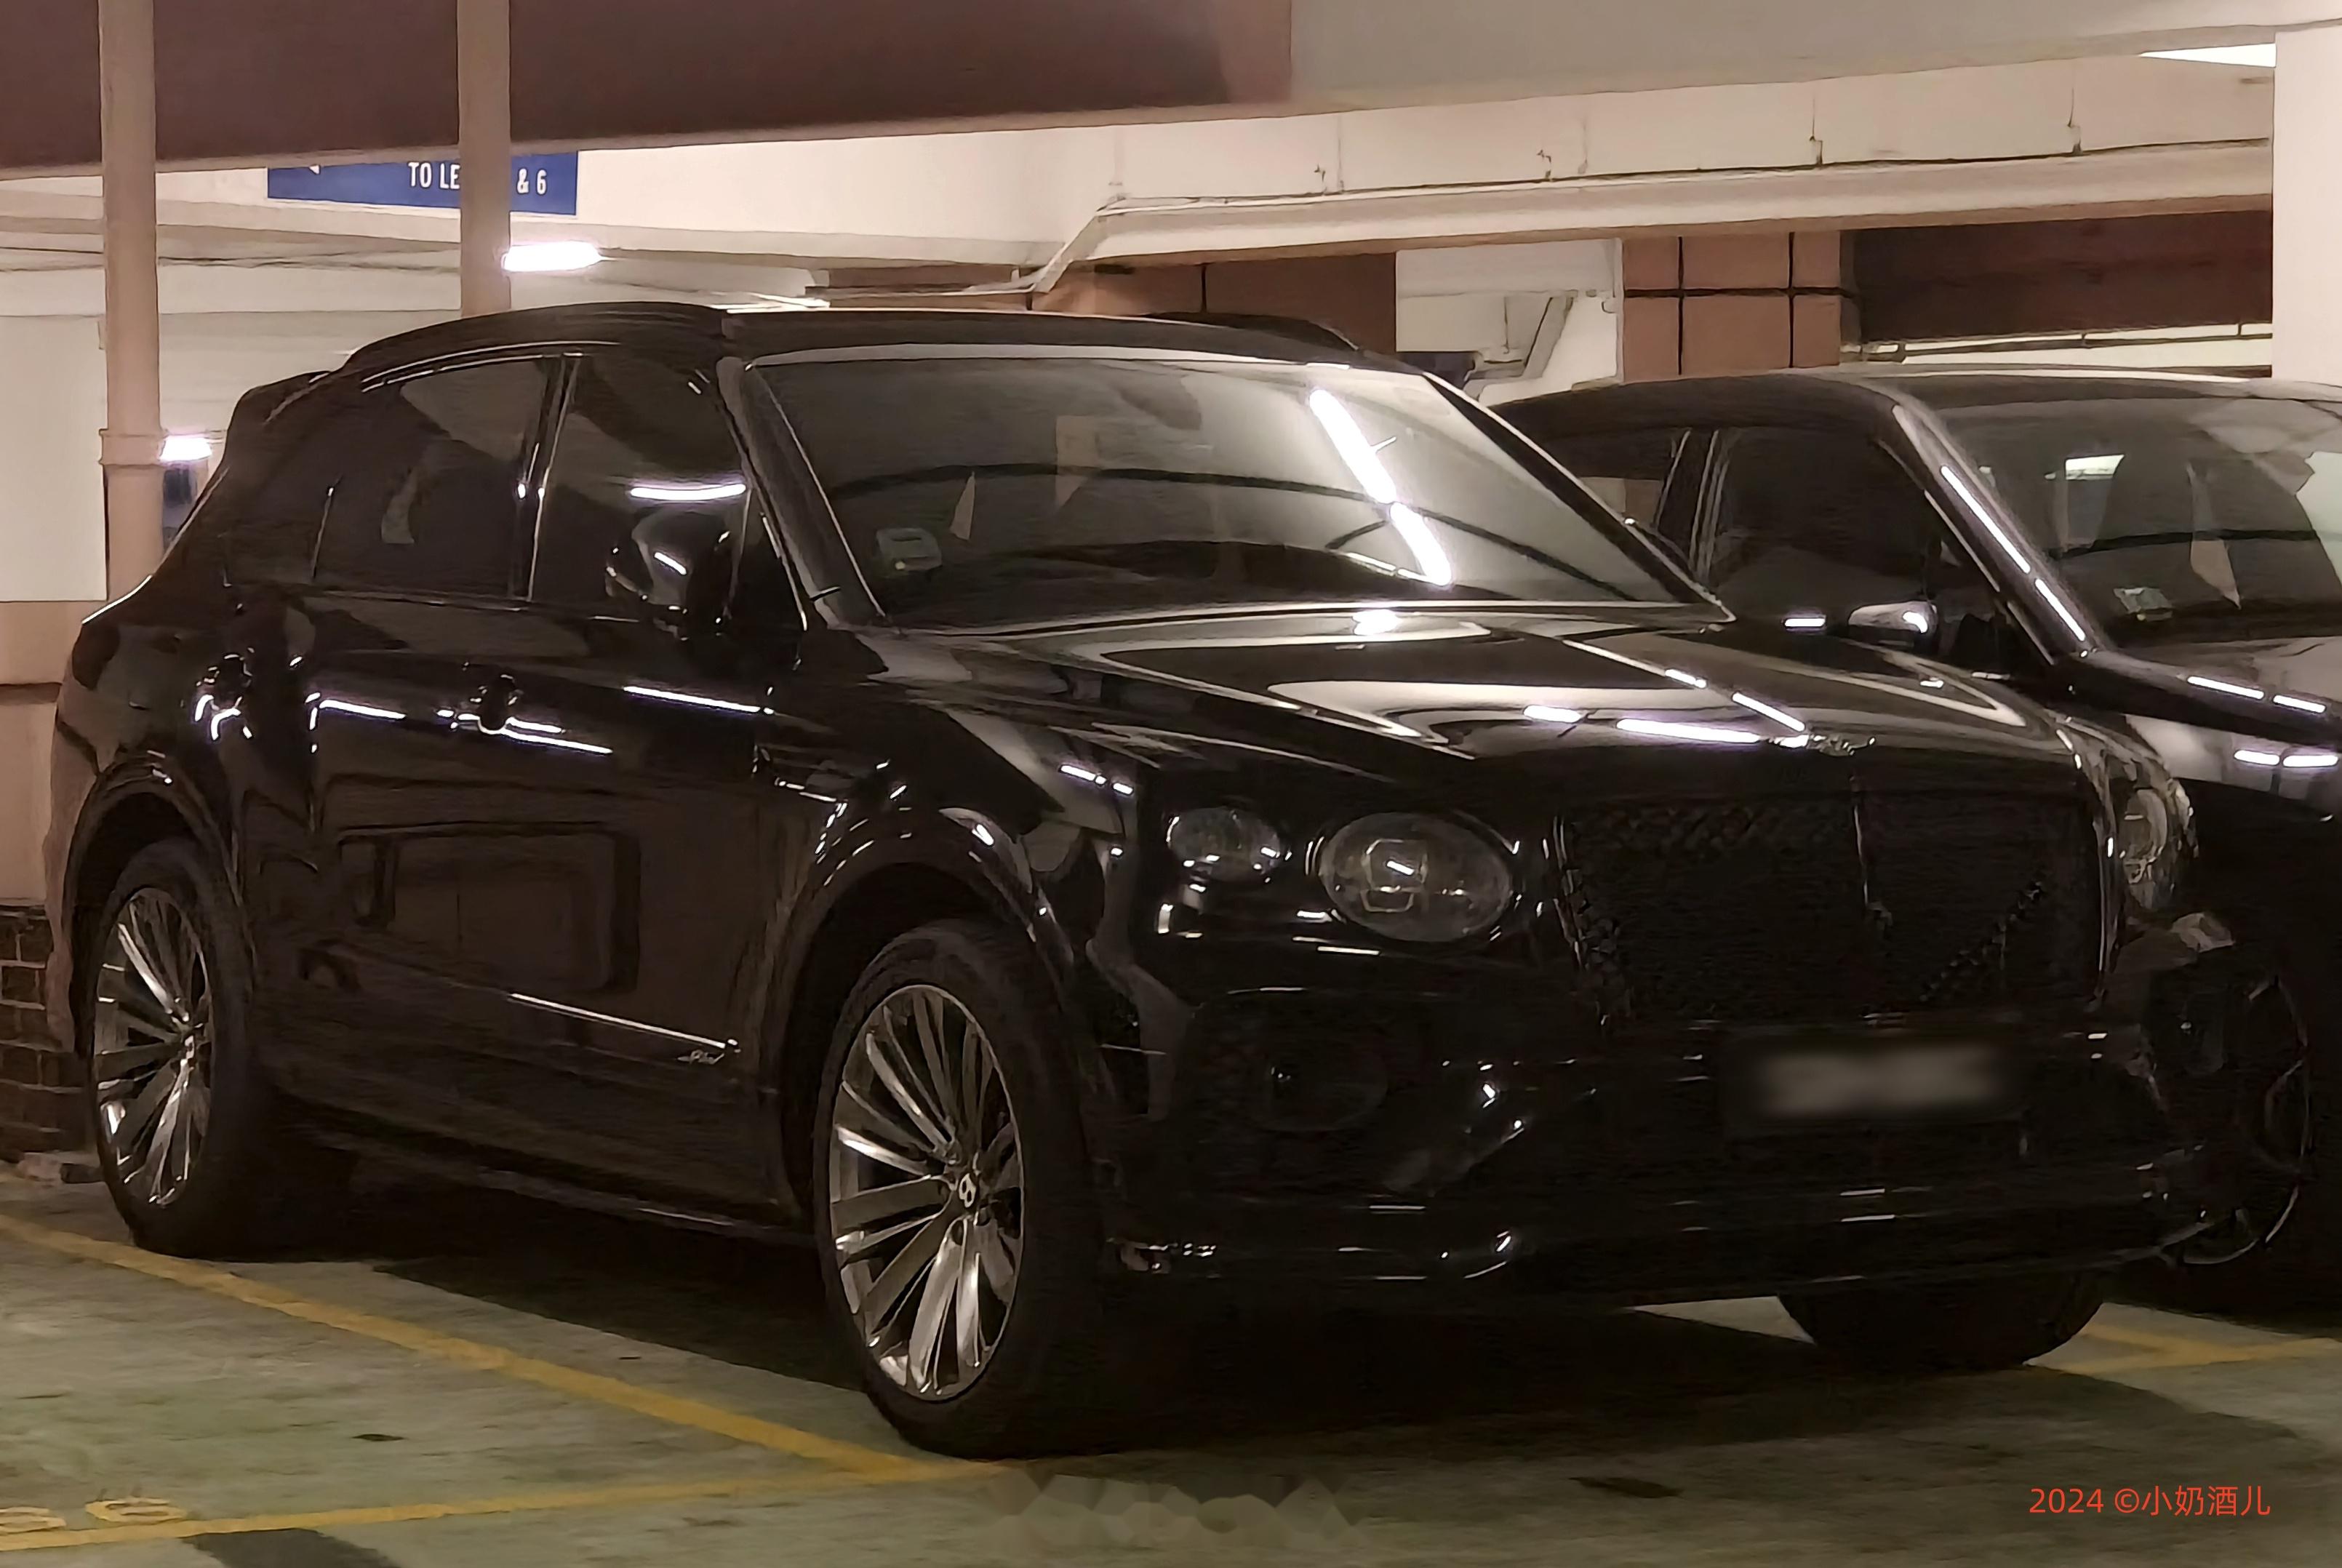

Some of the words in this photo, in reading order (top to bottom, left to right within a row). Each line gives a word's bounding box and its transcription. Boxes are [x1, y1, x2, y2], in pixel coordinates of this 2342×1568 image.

[408, 161, 433, 188] TO
[516, 167, 529, 194] &
[536, 169, 547, 195] 6
